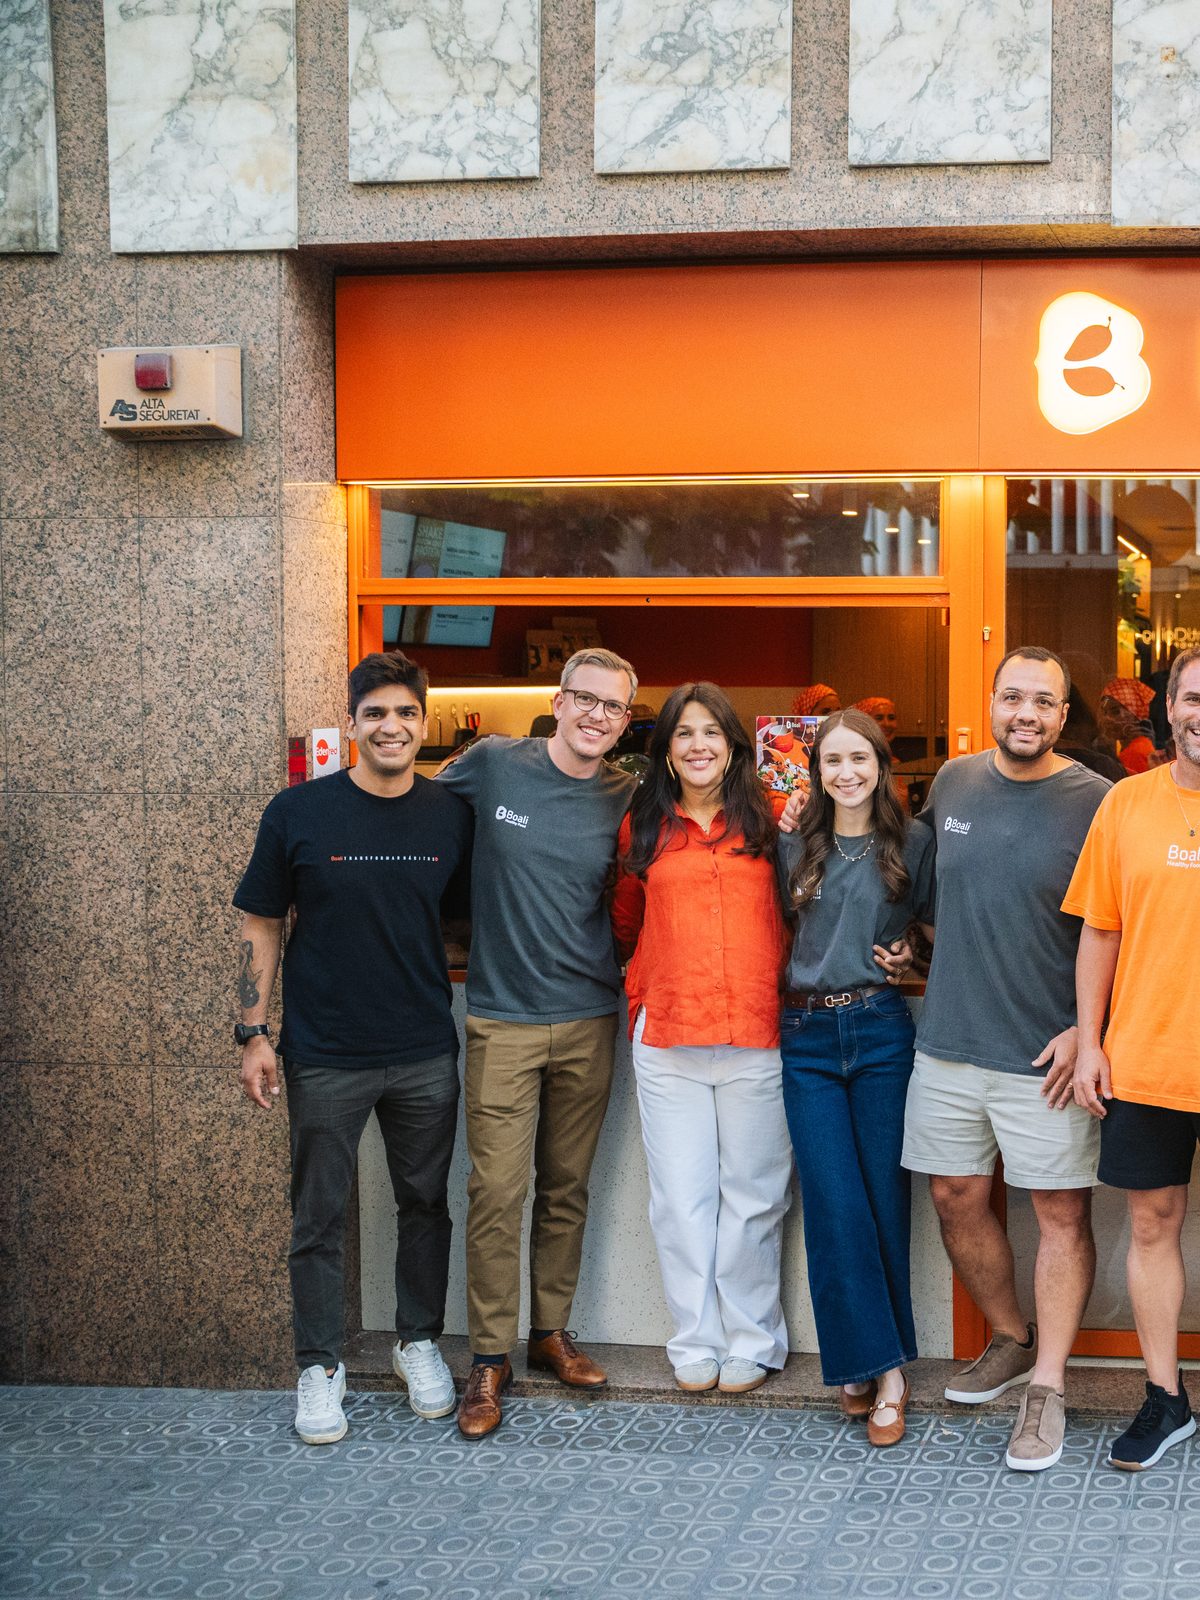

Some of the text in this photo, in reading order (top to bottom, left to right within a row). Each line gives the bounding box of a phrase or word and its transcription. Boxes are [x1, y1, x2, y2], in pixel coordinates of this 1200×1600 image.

[140, 398, 166, 409] ALTA
[140, 409, 200, 421] SEGURETAT
[507, 810, 529, 825] Boali
[952, 818, 971, 831] Boali
